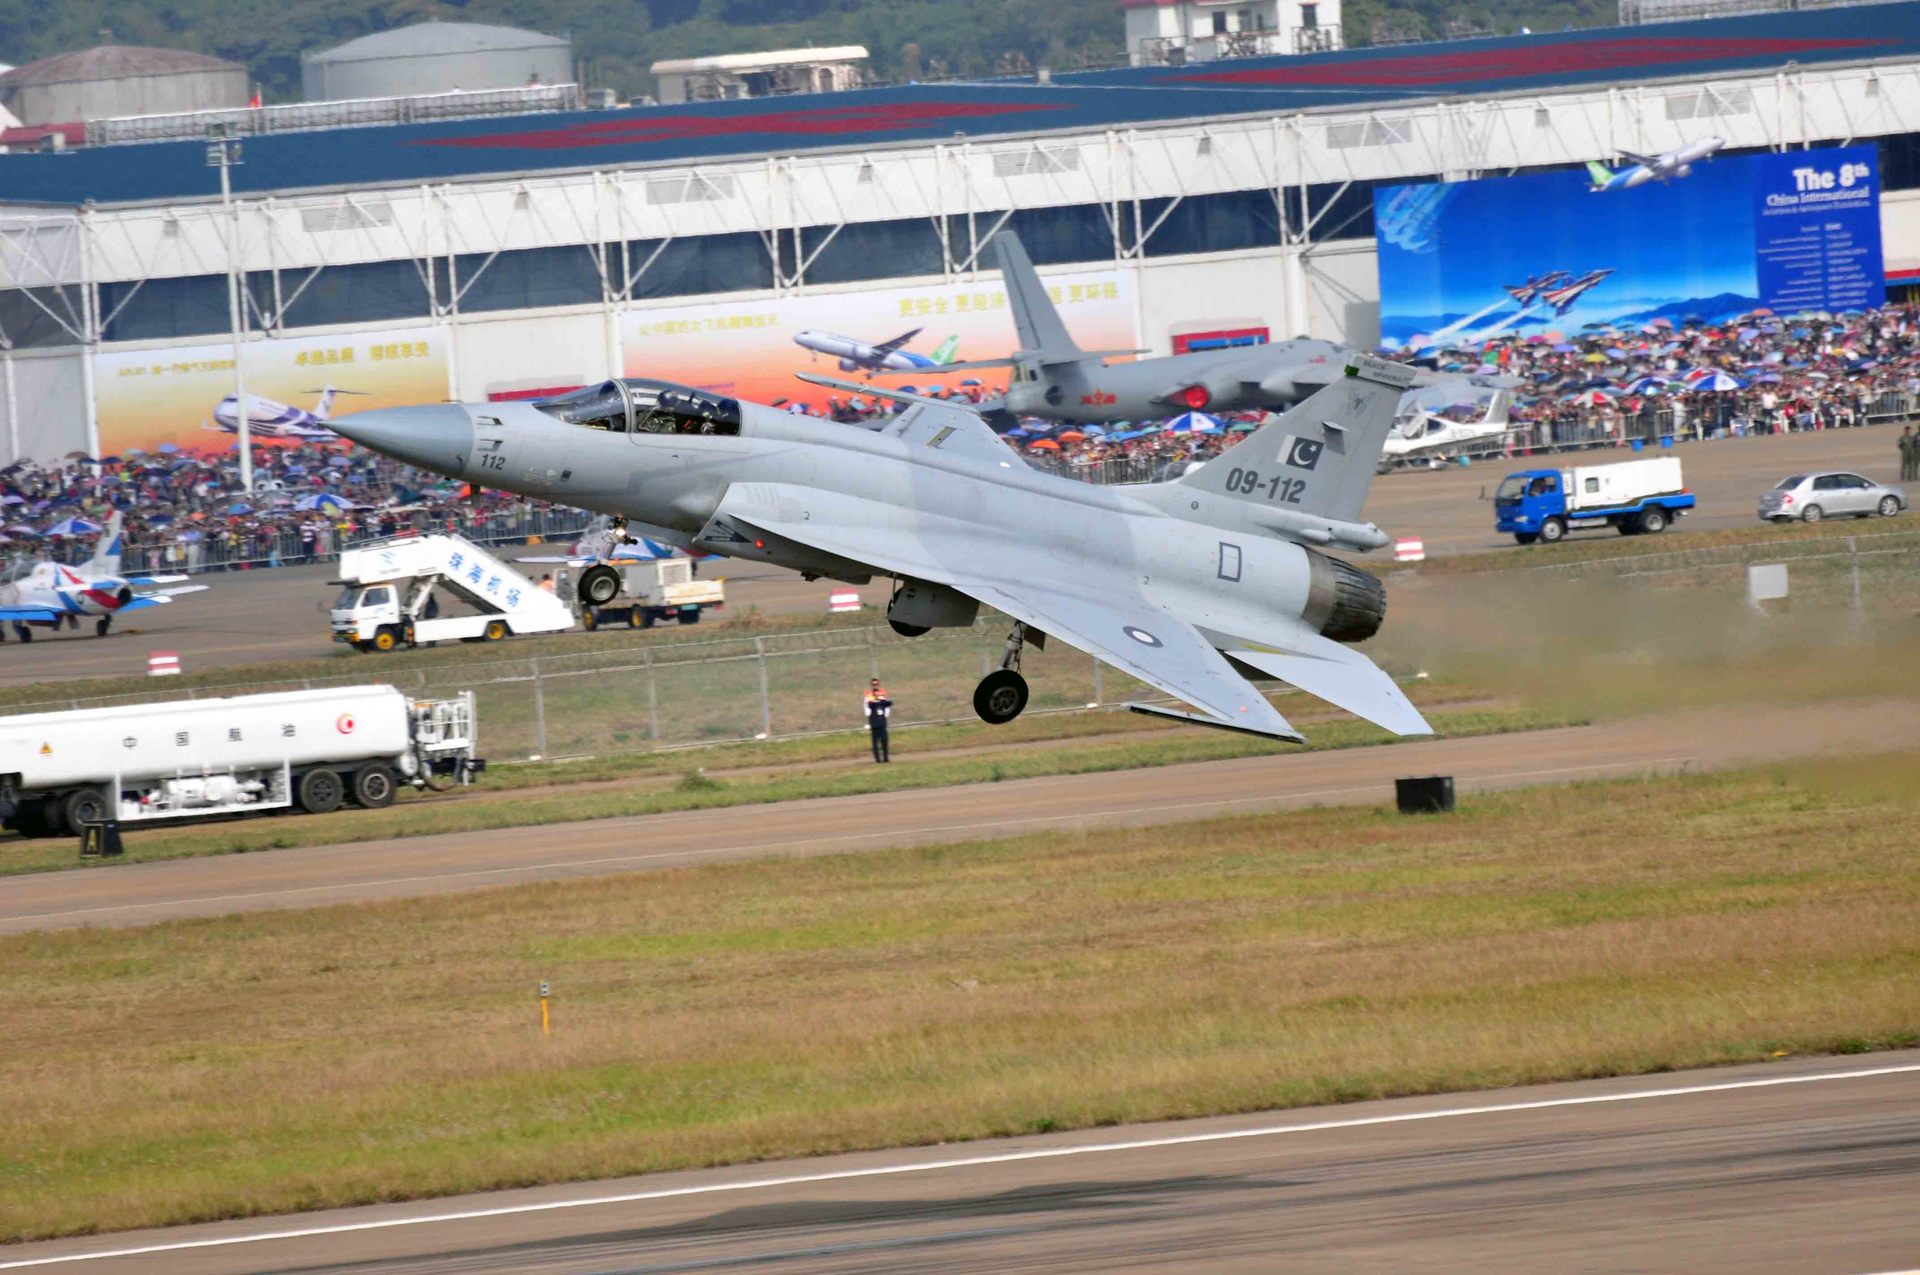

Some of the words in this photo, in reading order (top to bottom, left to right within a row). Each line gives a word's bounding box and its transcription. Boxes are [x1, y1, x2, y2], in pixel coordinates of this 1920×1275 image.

[1793, 166, 1836, 192] The
[1839, 162, 1871, 187] 8th
[1766, 193, 1799, 206] China
[1800, 186, 1870, 204] International
[481, 453, 506, 471] 112
[1225, 467, 1306, 504] 09-112
[449, 552, 521, 607] 珠海机场
